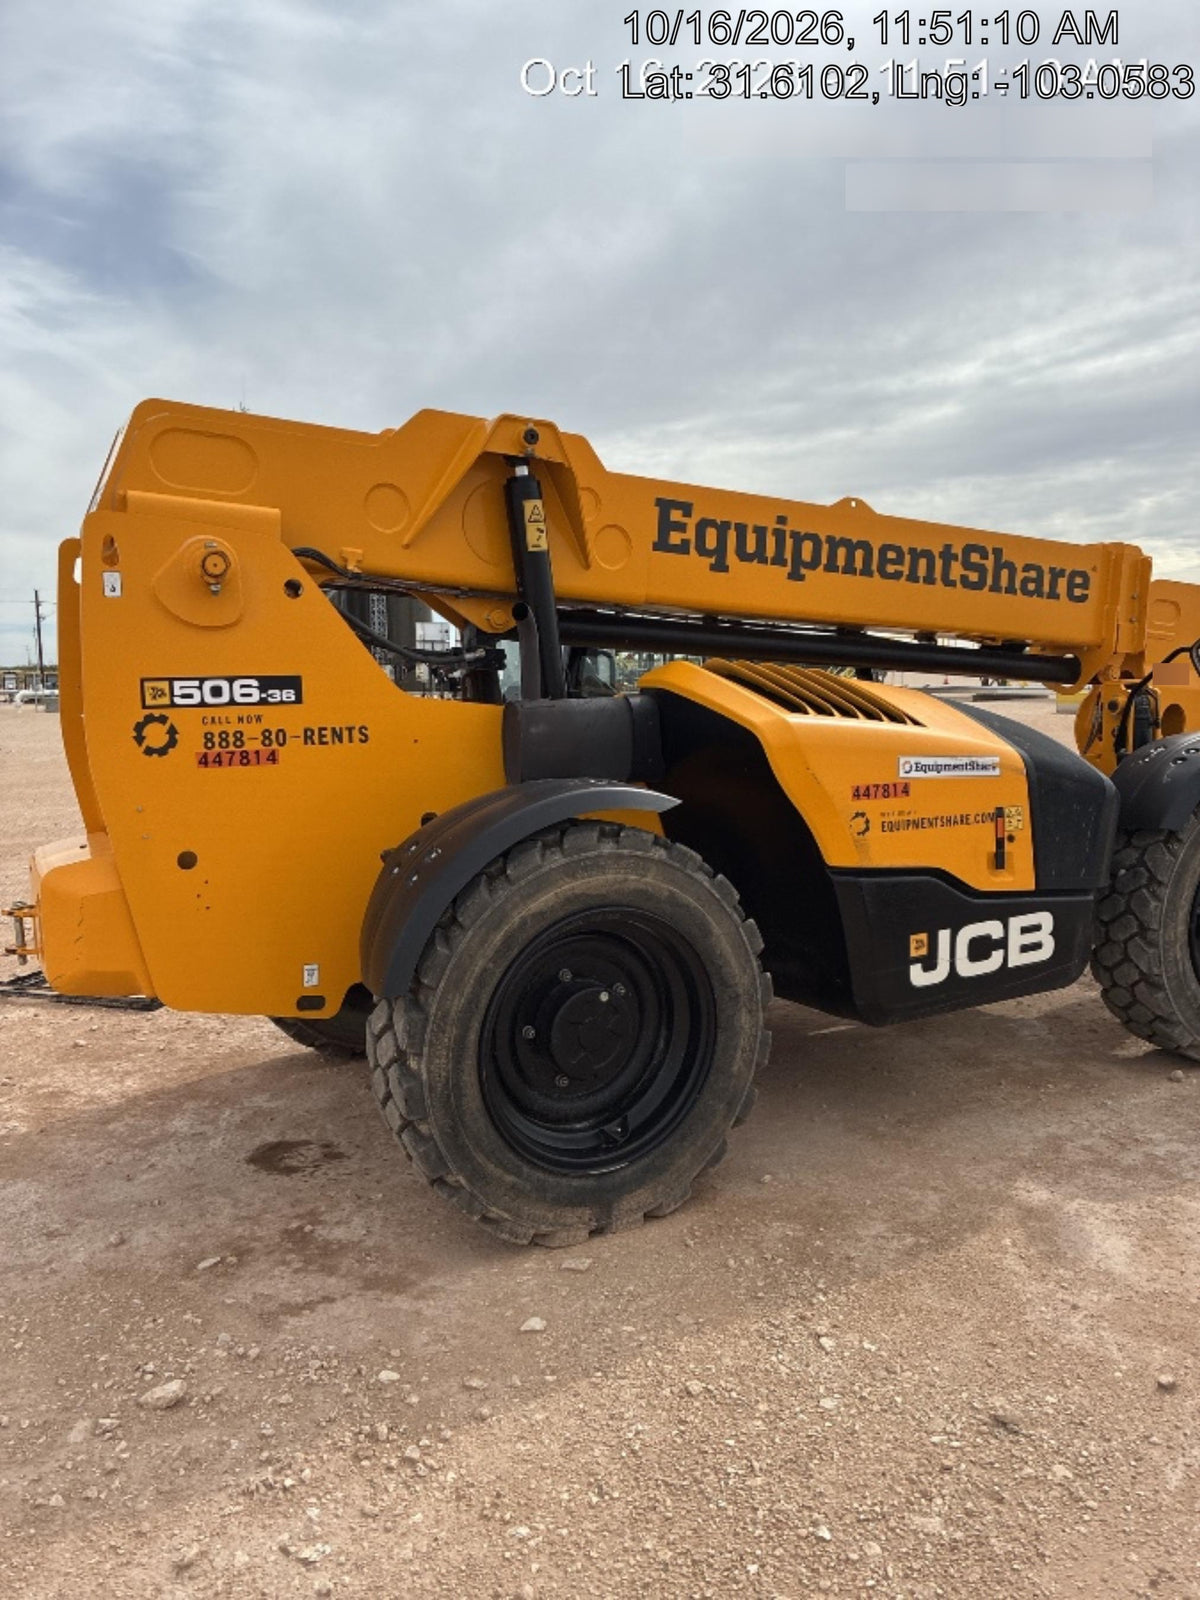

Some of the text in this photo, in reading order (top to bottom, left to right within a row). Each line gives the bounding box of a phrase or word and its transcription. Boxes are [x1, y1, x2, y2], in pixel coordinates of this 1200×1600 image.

[652, 497, 1091, 603] EquipmentShare
[172, 678, 297, 706] 506-36
[201, 714, 264, 726] CALL NOW
[203, 725, 370, 751] 888-80-RENTS
[197, 750, 278, 768] 447814
[852, 782, 911, 800] 447814
[909, 911, 1056, 988] JCB
